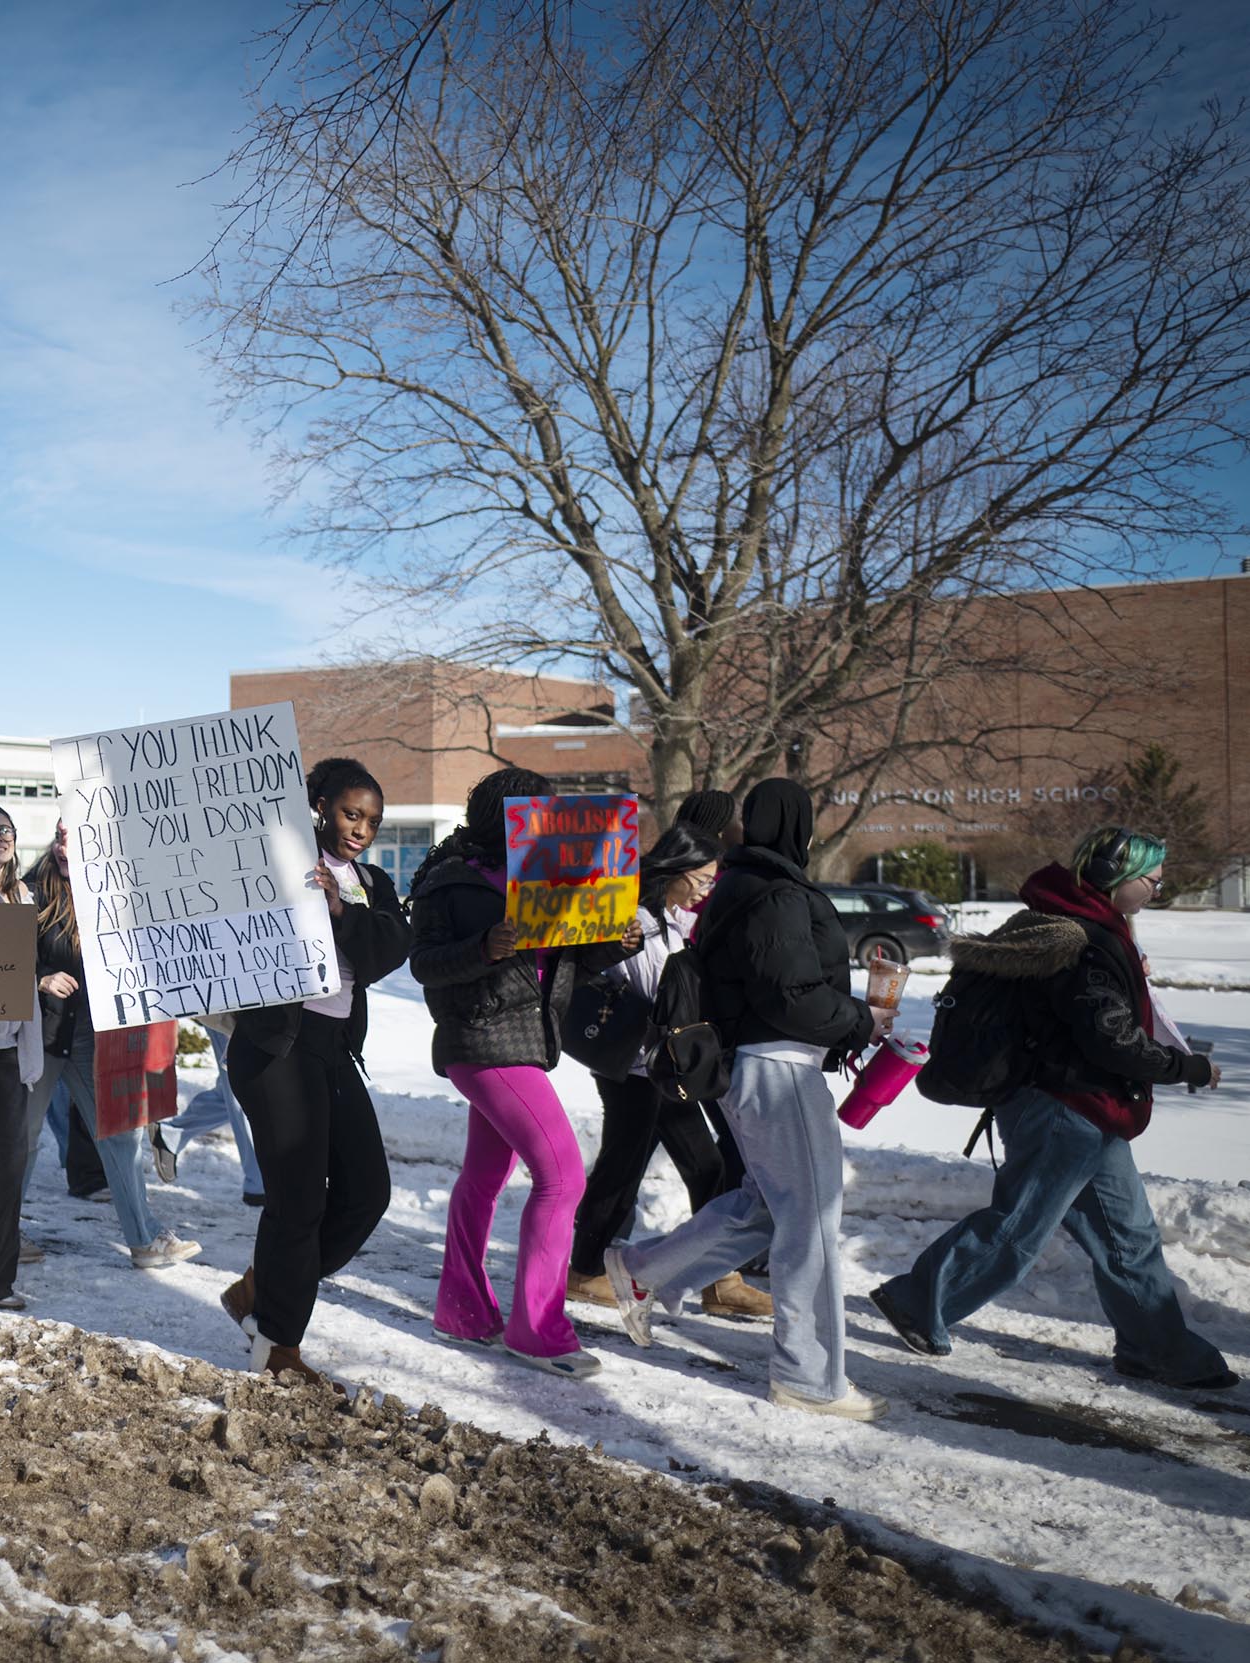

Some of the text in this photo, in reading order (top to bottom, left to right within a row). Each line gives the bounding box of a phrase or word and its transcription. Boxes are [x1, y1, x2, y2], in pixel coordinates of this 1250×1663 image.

[122, 728, 178, 772] YOU
[178, 714, 281, 763] THINK
[75, 750, 303, 822] YOU LOVE FREEDOM
[966, 787, 1021, 804] HIGH
[1032, 786, 1120, 803] SCHOO
[78, 796, 286, 863] BUT YOU DON'T
[526, 807, 622, 836] ABOLISH
[84, 857, 151, 893] CARE
[226, 834, 271, 872] IT
[559, 841, 595, 867] ICE
[96, 874, 277, 932] APPLIES TO
[517, 883, 627, 920] PROTECT
[96, 907, 297, 967] EVERYONE WHAT
[105, 938, 326, 991] YOU ACTUALLY LOVE IS
[113, 963, 330, 1026] PRIVILEGE!
